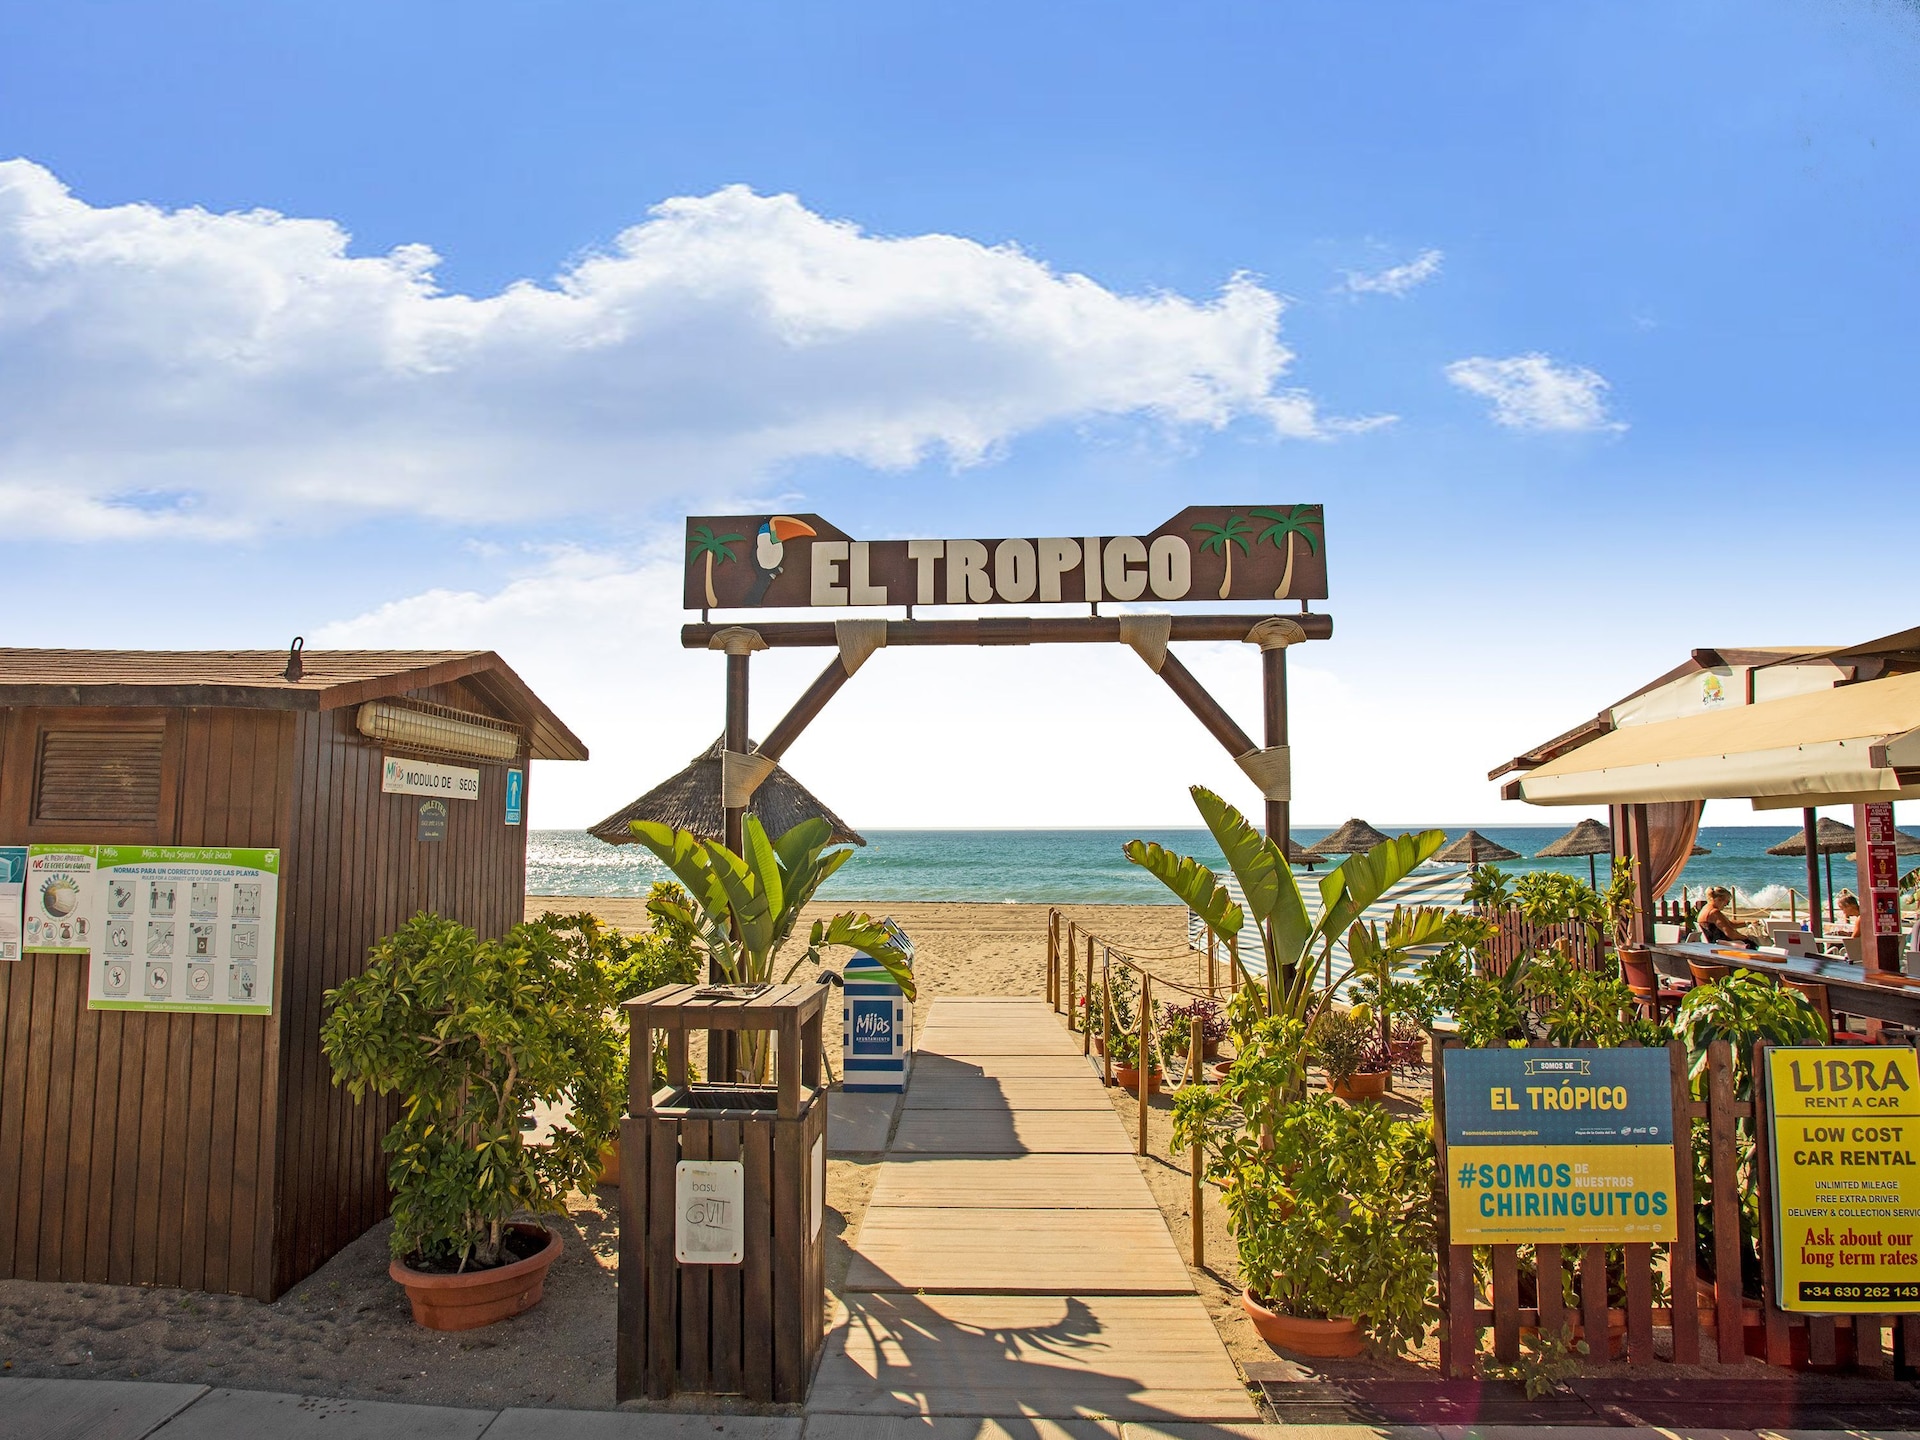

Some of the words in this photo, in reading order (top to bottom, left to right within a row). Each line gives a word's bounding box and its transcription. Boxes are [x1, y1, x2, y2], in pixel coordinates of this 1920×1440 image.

[811, 541, 887, 606] EL
[908, 535, 1191, 604] TROPICO
[386, 761, 403, 782] Mijas
[407, 772, 439, 788] MODULO
[442, 776, 451, 788] DE
[456, 777, 477, 792] SEOS
[419, 800, 447, 817] TOILETTES
[103, 848, 118, 857] Mijas
[161, 850, 176, 860] Playa
[177, 850, 195, 860] Segura
[201, 850, 214, 859] Safe
[215, 851, 232, 859] Beach
[32, 860, 43, 868] NO
[856, 1013, 890, 1037] Mijas
[1789, 1060, 1910, 1092] LIBRA
[1490, 1087, 1519, 1111] EL
[1526, 1079, 1627, 1111] TRÓPICO
[1805, 1097, 1847, 1107] RENT
[1852, 1097, 1862, 1107] A
[1866, 1097, 1899, 1107] CAR
[1803, 1128, 1845, 1142] LOW
[1852, 1128, 1903, 1142] COST
[1793, 1151, 1834, 1165] CAR
[1840, 1151, 1916, 1165] RENTAL
[1458, 1163, 1571, 1188] #SOMOS
[1574, 1163, 1589, 1174] DE
[1574, 1176, 1634, 1188] NUESTROS
[1815, 1181, 1859, 1189] UNLIMITED
[1861, 1181, 1898, 1189] MILEAGE
[1479, 1191, 1668, 1217] CHIRINGUITOS
[1815, 1195, 1837, 1203] FREE
[1840, 1195, 1867, 1203] EXTRA
[1869, 1195, 1899, 1203] DRIVER
[1788, 1209, 1828, 1217] DELIVERY
[1830, 1209, 1836, 1217] &
[1838, 1209, 1891, 1217] COLLECTION
[1804, 1227, 1835, 1246] Ask
[1840, 1227, 1883, 1246] about
[1887, 1233, 1913, 1246] our
[1801, 1247, 1835, 1268] long
[1839, 1250, 1875, 1265] term
[1880, 1250, 1918, 1265] rates
[1804, 1287, 1830, 1296] +34
[1834, 1287, 1860, 1296] 630
[1864, 1287, 1890, 1296] 262
[1894, 1287, 1919, 1296] 143
